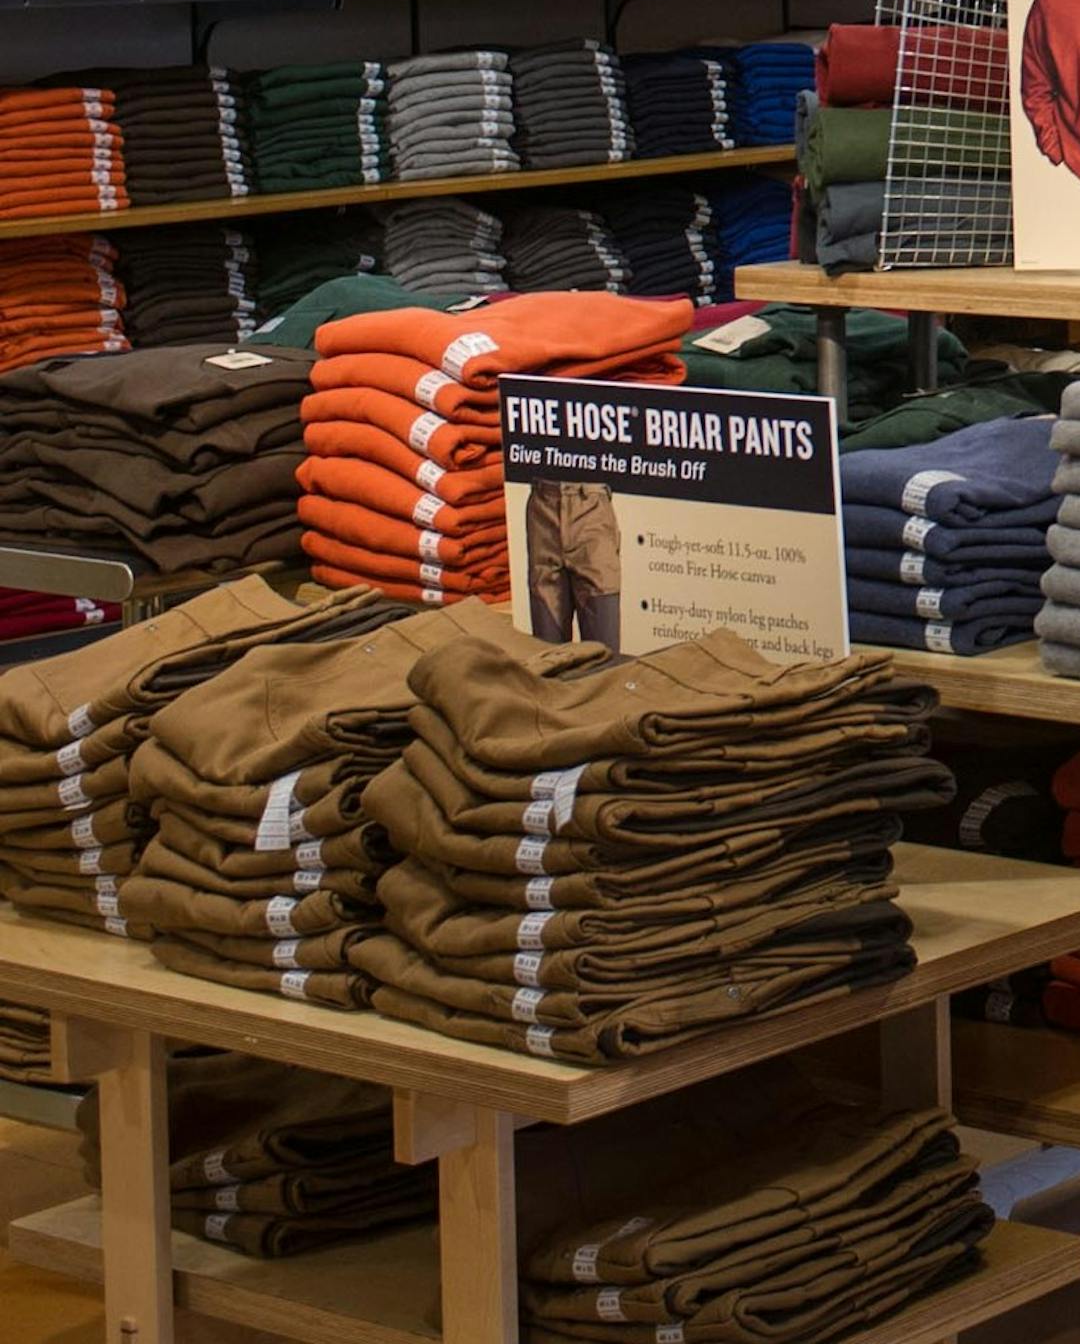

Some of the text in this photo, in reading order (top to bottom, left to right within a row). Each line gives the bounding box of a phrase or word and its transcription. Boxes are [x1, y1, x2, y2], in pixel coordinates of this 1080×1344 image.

[506, 396, 560, 437] FIRE
[645, 409, 723, 453] BRIAR
[729, 415, 814, 460] PANTS
[509, 444, 707, 481] Give Thorns the Brush Off
[648, 532, 725, 555] Tough-yet-soft
[775, 547, 807, 564] 100%
[648, 559, 776, 585] cotton Fire Hose canvas
[651, 597, 809, 632] Heavy-duty nylon leg patches
[653, 624, 699, 640] reinforce
[761, 636, 781, 652] and
[784, 637, 809, 656] back
[812, 642, 834, 660] legs
